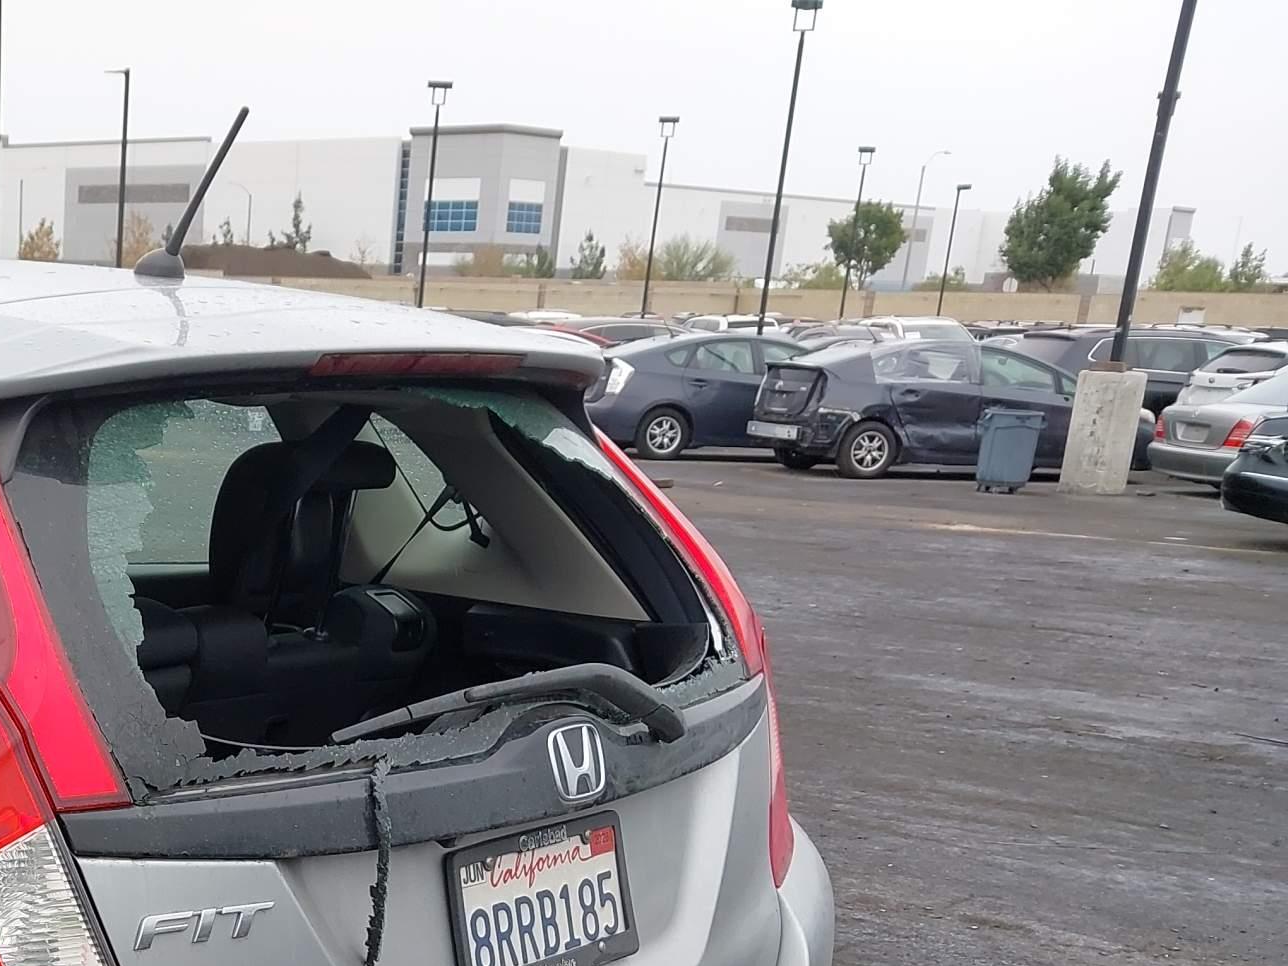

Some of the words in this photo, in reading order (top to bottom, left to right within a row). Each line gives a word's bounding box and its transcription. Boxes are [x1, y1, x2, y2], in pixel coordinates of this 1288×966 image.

[462, 862, 485, 885] JUN
[489, 844, 592, 888] California
[133, 901, 275, 951] FIT
